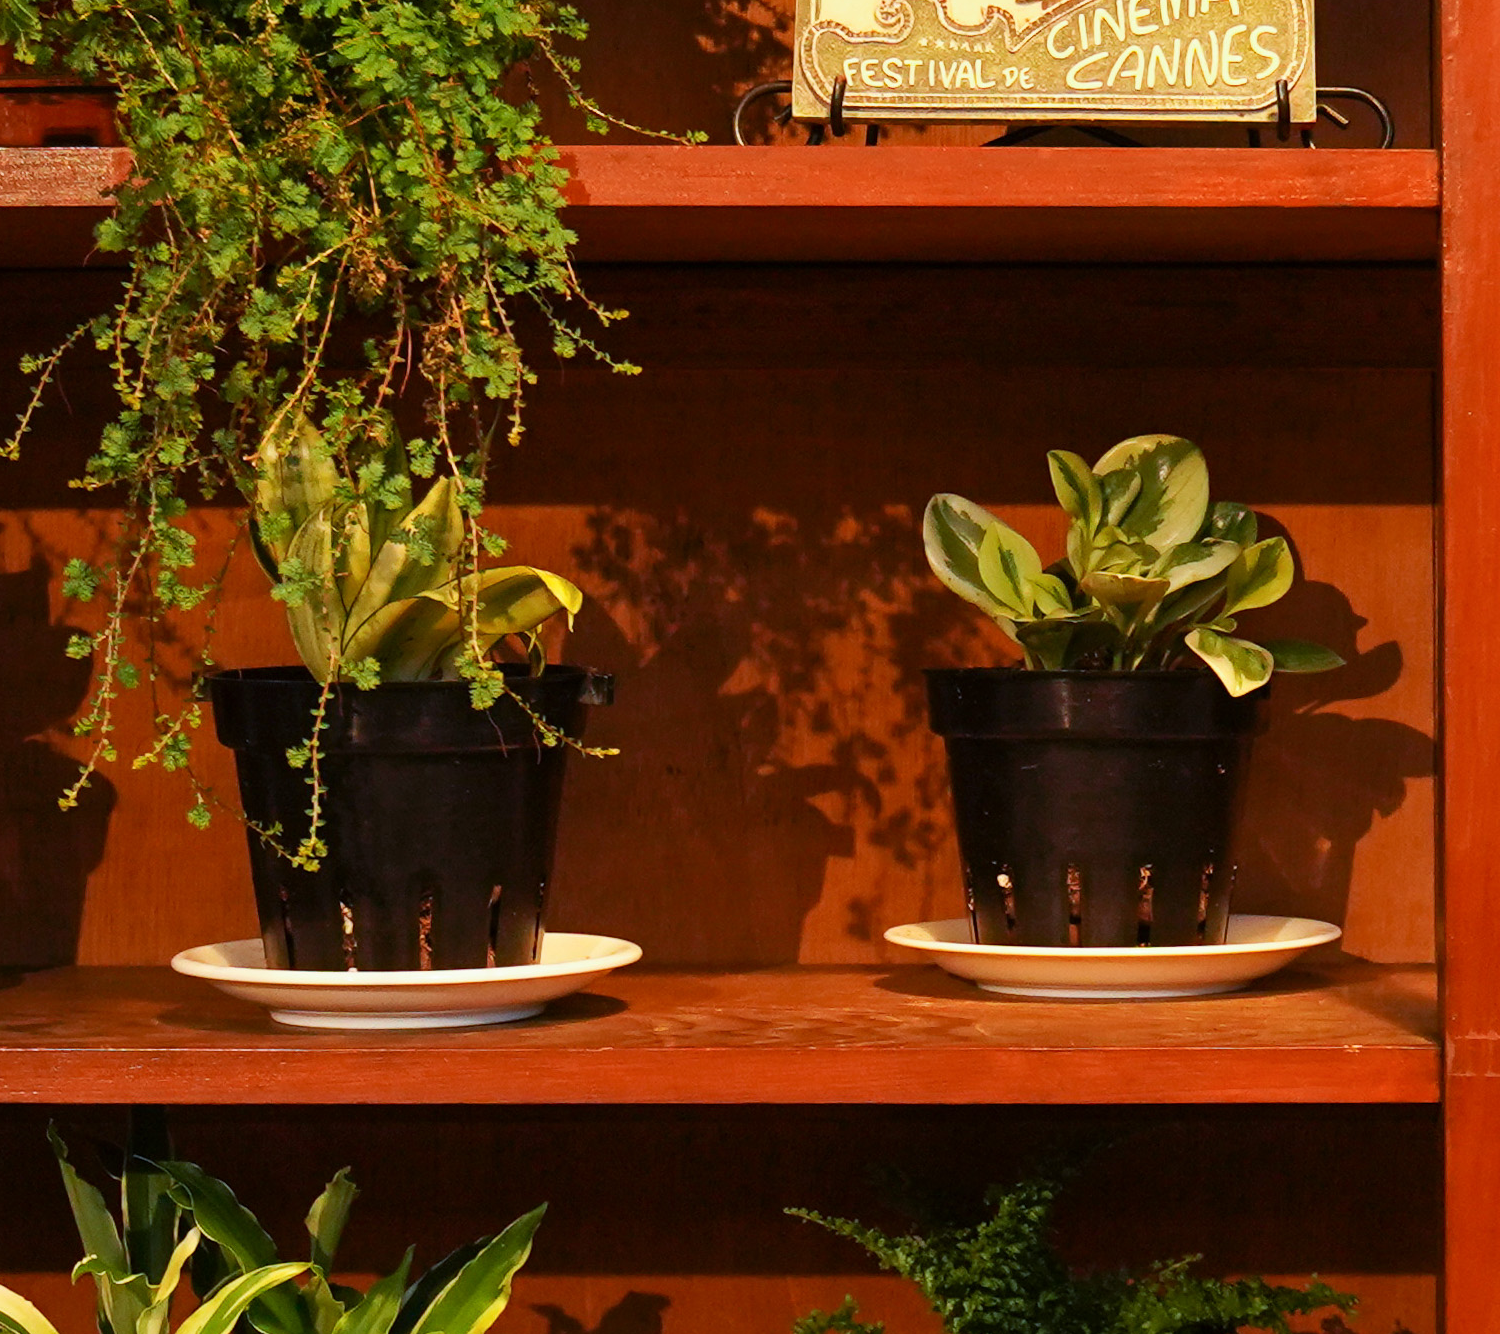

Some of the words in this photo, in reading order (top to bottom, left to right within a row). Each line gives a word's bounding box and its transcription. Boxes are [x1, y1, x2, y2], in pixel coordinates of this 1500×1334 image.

[843, 57, 995, 89] FESTIVAL
[1002, 66, 1035, 90] DE
[1064, 24, 1281, 91] CANNES
